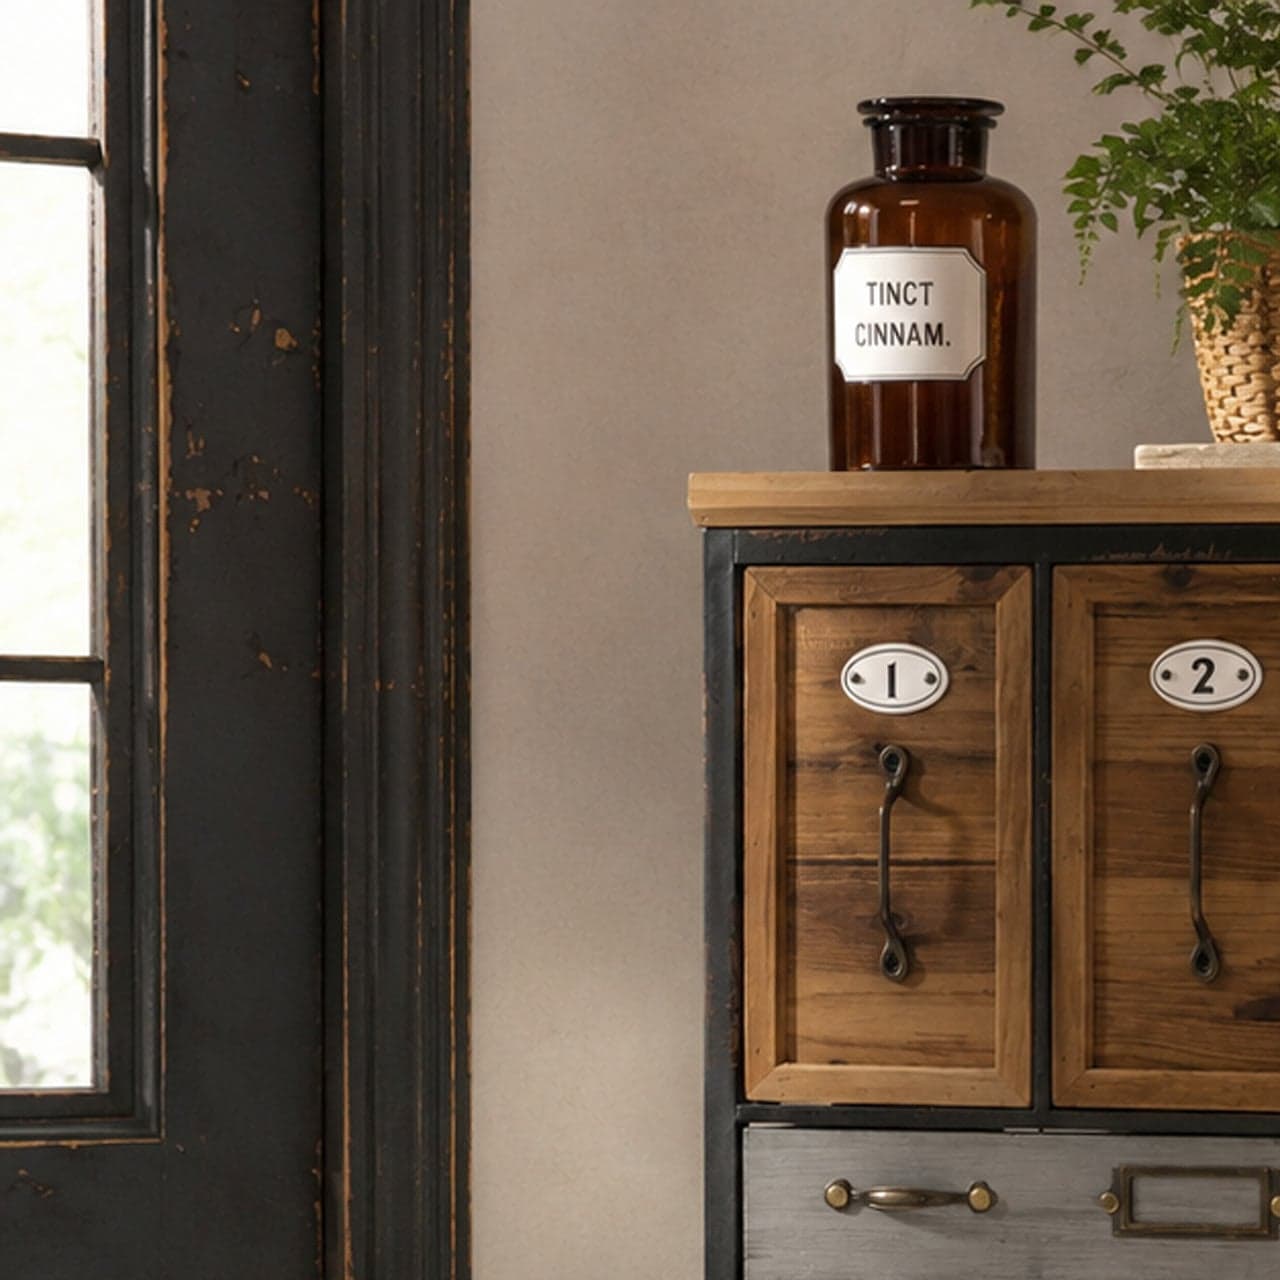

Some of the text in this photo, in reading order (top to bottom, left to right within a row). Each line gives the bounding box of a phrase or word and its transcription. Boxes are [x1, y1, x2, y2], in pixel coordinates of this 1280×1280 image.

[866, 281, 934, 306] TINCT
[855, 322, 951, 347] CINNAM.
[887, 661, 897, 699] 1
[1192, 656, 1215, 695] 2
